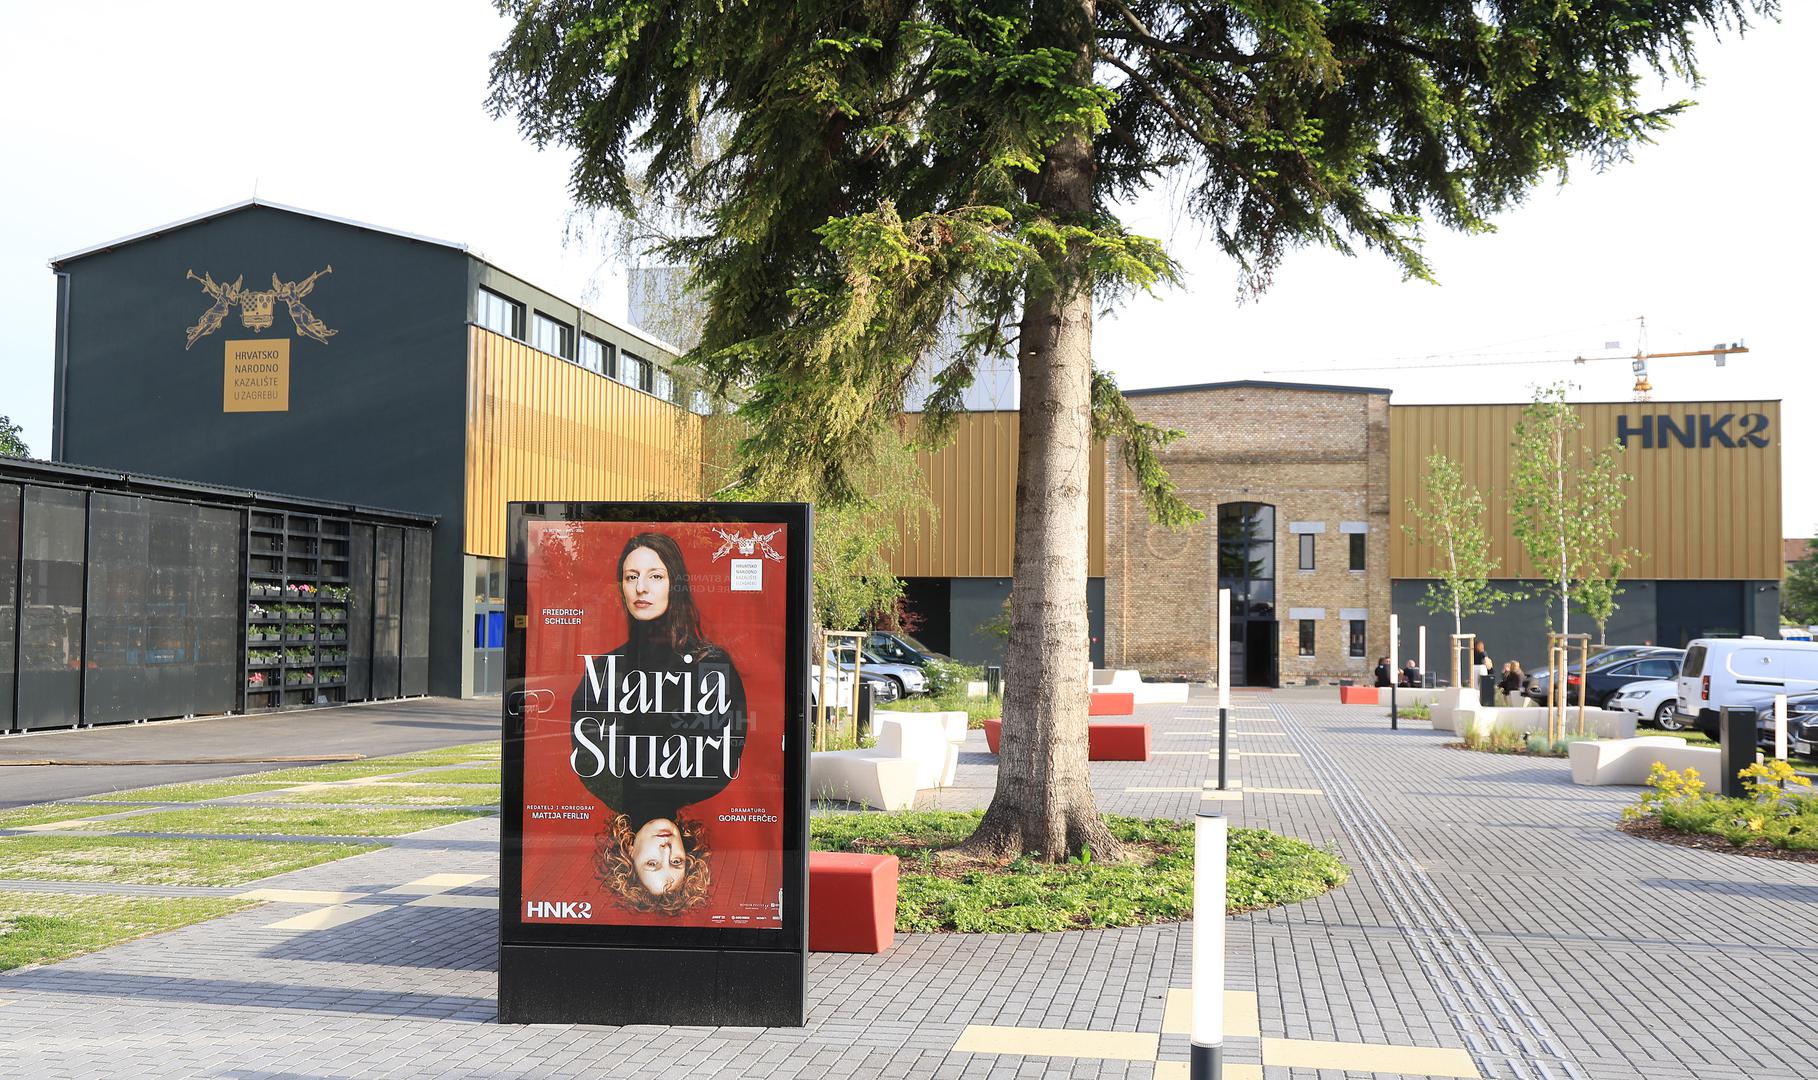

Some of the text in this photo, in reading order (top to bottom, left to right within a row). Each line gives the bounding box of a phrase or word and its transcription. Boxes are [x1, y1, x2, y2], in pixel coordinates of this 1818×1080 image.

[235, 350, 279, 360] HRVATSKO
[234, 363, 279, 373] NARODNO
[234, 376, 279, 387] KAZALIŠTE
[233, 389, 279, 400] U ZAGREBU
[1617, 413, 1770, 448] HNK2
[542, 608, 584, 616] FRIEDRICH
[544, 617, 582, 625] SCHILLER
[577, 654, 732, 715] Maria
[570, 716, 744, 780] Stuart
[562, 812, 590, 820] FERLIN
[718, 813, 778, 823] GORAN FERČEC
[527, 901, 592, 919] HNK2
